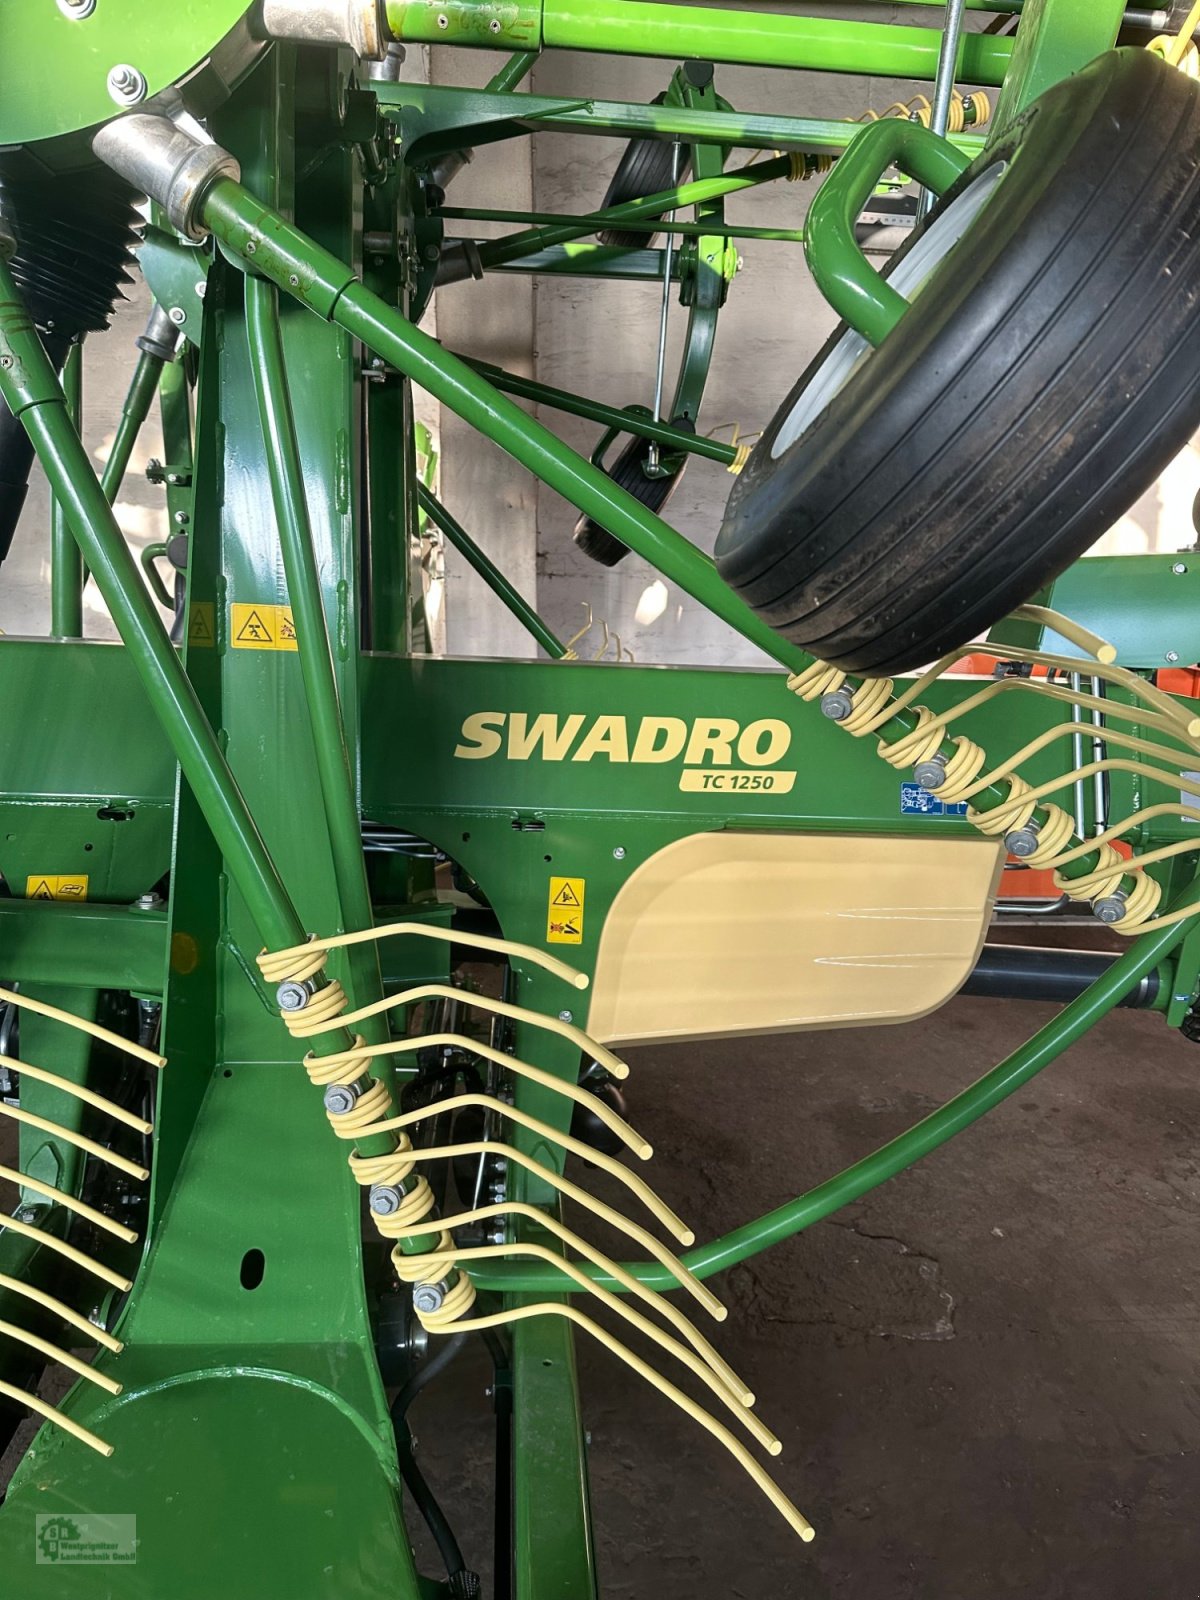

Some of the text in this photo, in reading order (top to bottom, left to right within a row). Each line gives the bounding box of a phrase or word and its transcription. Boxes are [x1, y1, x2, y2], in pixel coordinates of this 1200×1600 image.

[454, 711, 792, 766] SWADRO
[702, 775, 775, 790] TC 1250
